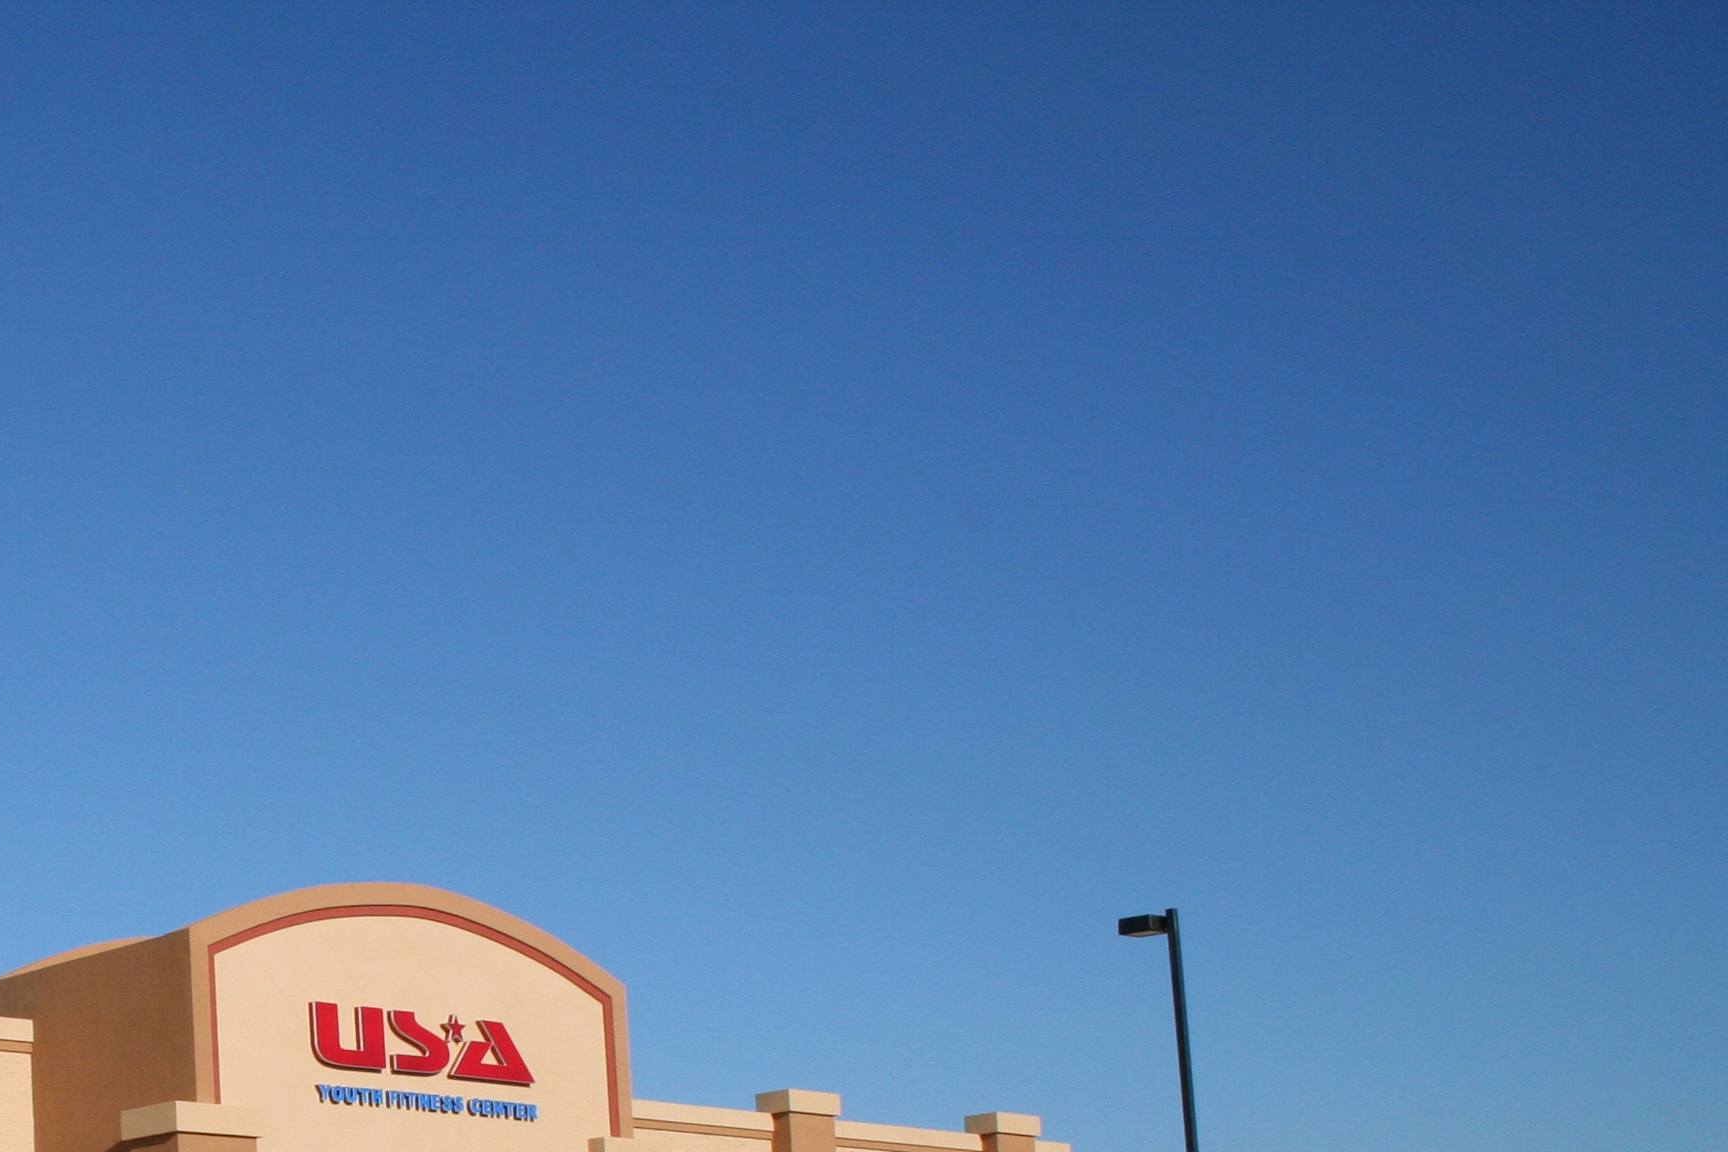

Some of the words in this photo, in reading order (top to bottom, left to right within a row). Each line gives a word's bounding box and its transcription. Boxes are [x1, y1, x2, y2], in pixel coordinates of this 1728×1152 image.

[309, 1000, 535, 1087] USA
[315, 1084, 383, 1105] YOUTH
[387, 1090, 464, 1113] FITNESS
[468, 1098, 538, 1121] CENTER
